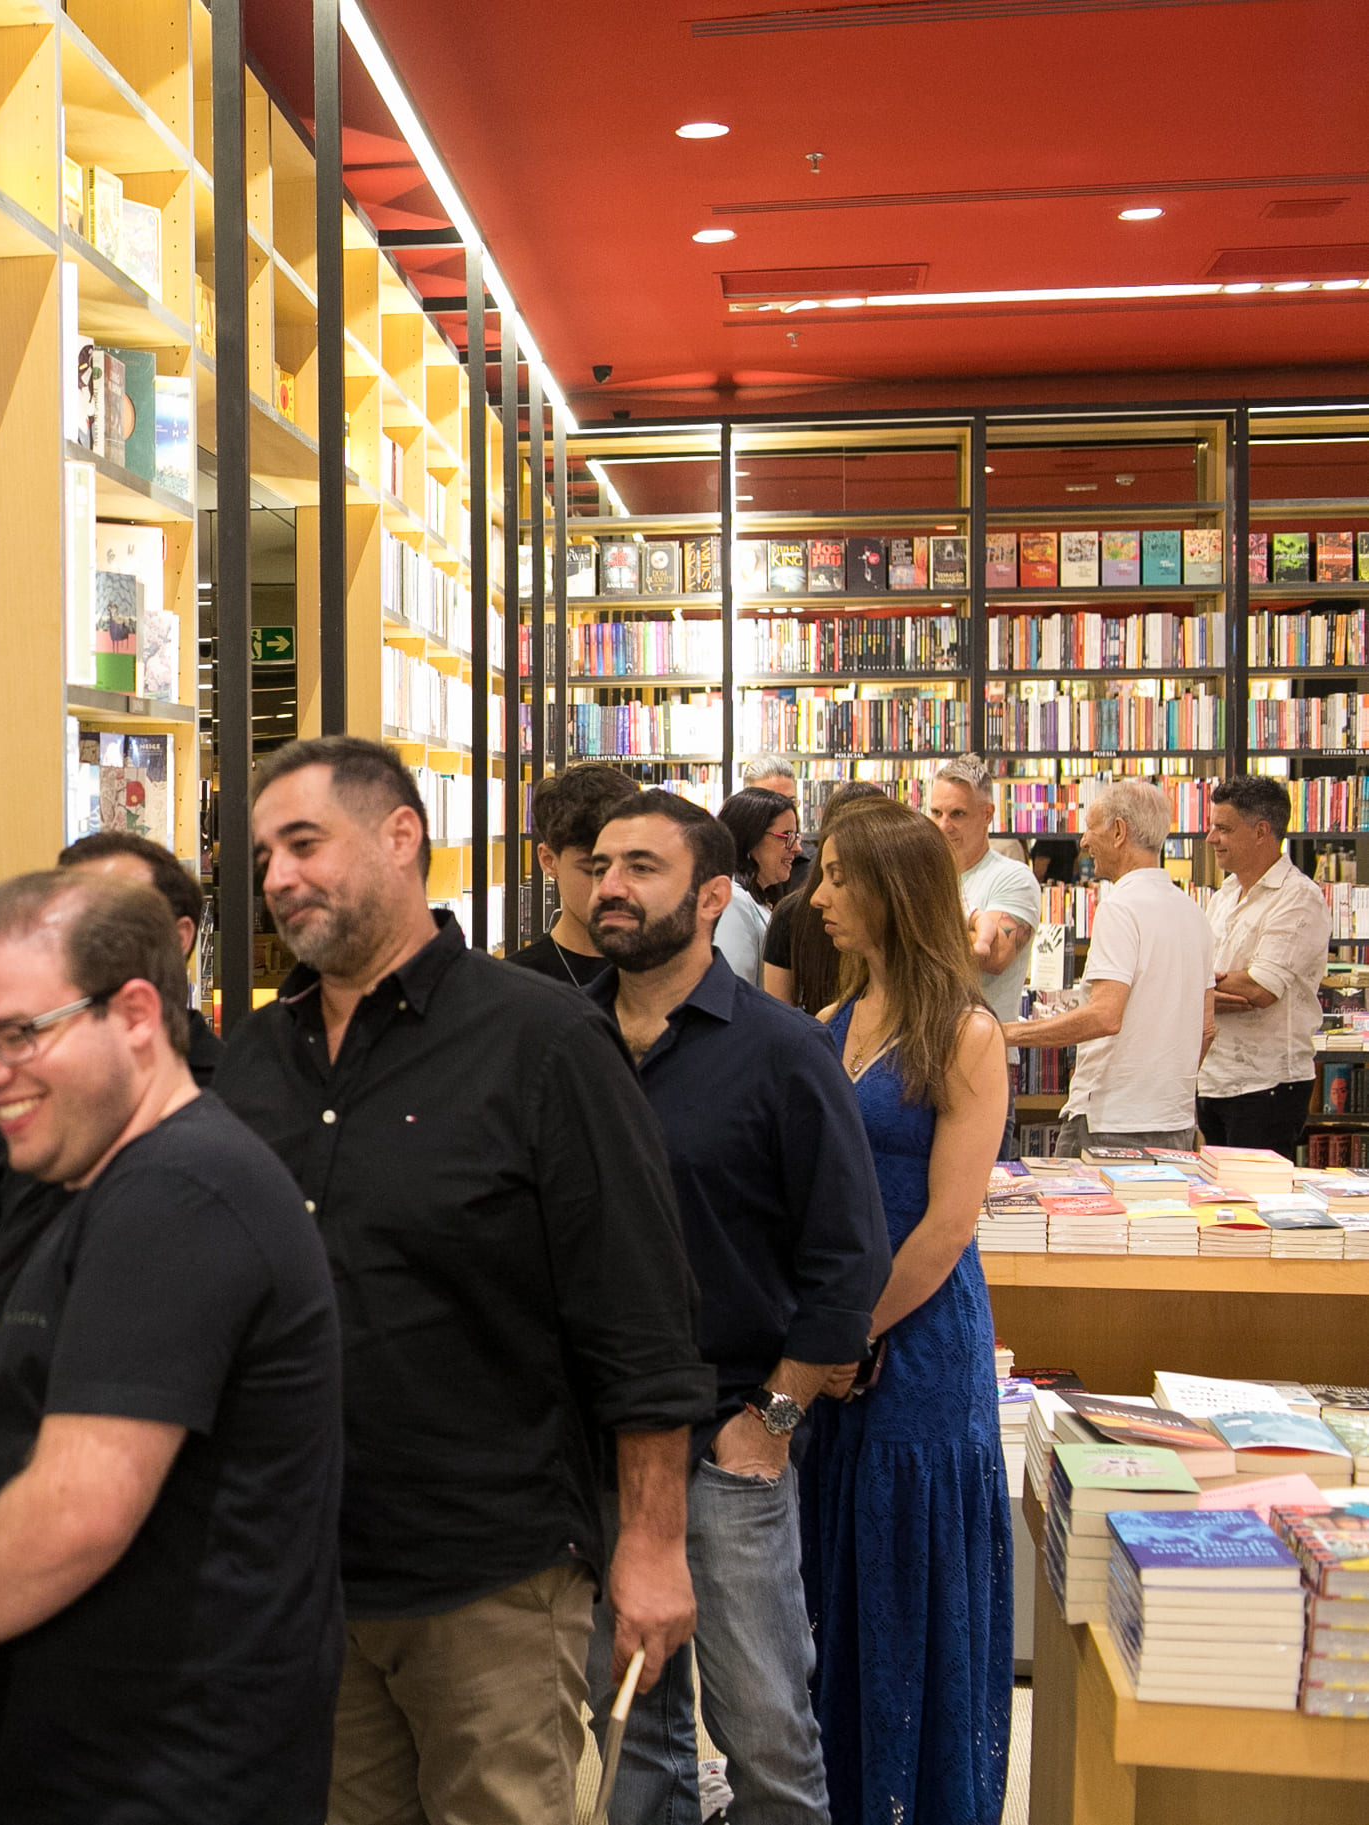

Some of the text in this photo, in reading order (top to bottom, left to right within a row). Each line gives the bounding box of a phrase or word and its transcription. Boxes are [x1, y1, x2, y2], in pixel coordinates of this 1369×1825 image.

[770, 543, 802, 554] STEPHEN
[811, 541, 841, 555] Joe
[770, 553, 803, 567] KING
[622, 754, 665, 762] ESTRANGEIRA
[834, 752, 865, 760] POLICIAL
